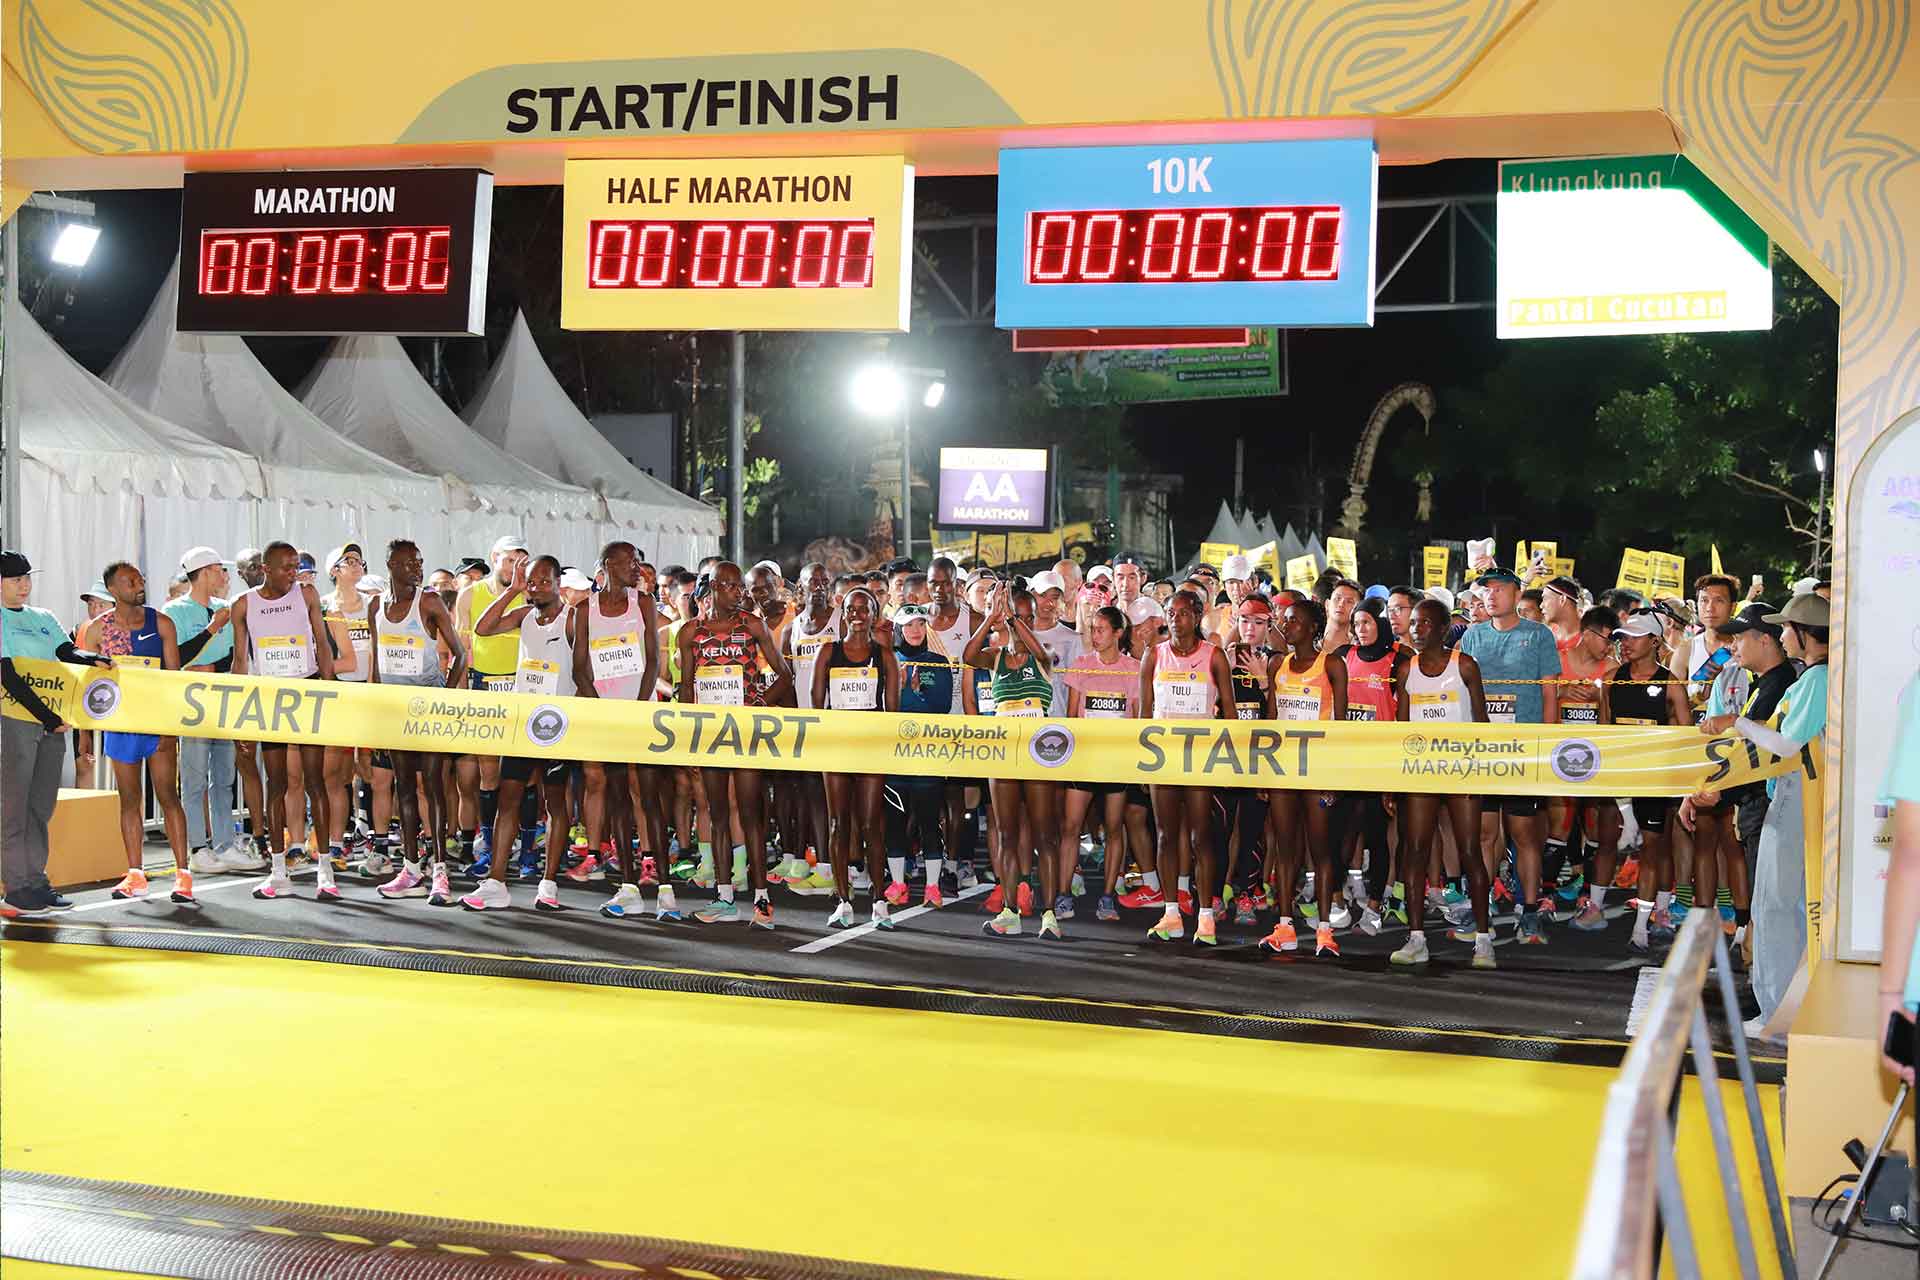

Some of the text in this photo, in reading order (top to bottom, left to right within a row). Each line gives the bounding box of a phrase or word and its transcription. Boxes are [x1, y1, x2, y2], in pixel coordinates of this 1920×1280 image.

[507, 75, 898, 133] START/FINISH
[1147, 157, 1213, 193] 10K
[608, 175, 852, 204] HALF MARATHON
[253, 186, 396, 214] MARATHON
[1033, 211, 1341, 280] 00:00:00
[206, 230, 449, 295] 00:00:00
[592, 225, 874, 288] 00:00:00
[963, 471, 1020, 502] AA
[953, 507, 1029, 521] MARATHON
[260, 605, 292, 615] KIPRUN
[349, 630, 368, 640] 0214
[599, 648, 633, 662] OCHIENG
[702, 646, 743, 657] KENYA
[802, 644, 820, 655] 101
[22, 672, 64, 691] bank
[489, 682, 513, 692] 10107
[699, 680, 739, 691] ONYANCHA
[840, 682, 868, 693] AKENO
[1171, 685, 1192, 696] TULU
[180, 682, 338, 734] START
[429, 702, 507, 719] Maybank
[1091, 698, 1119, 709] 20804
[1346, 710, 1367, 721] 1124
[1423, 708, 1445, 719] RONO
[1567, 709, 1595, 720] 30802
[403, 719, 505, 742] MARATHON
[647, 709, 820, 758] START
[922, 723, 1008, 742] Maybank
[894, 741, 1005, 762] MARATHON
[1136, 727, 1325, 776] START
[1430, 737, 1524, 755] Maybank
[1401, 756, 1525, 780] MARATHON
